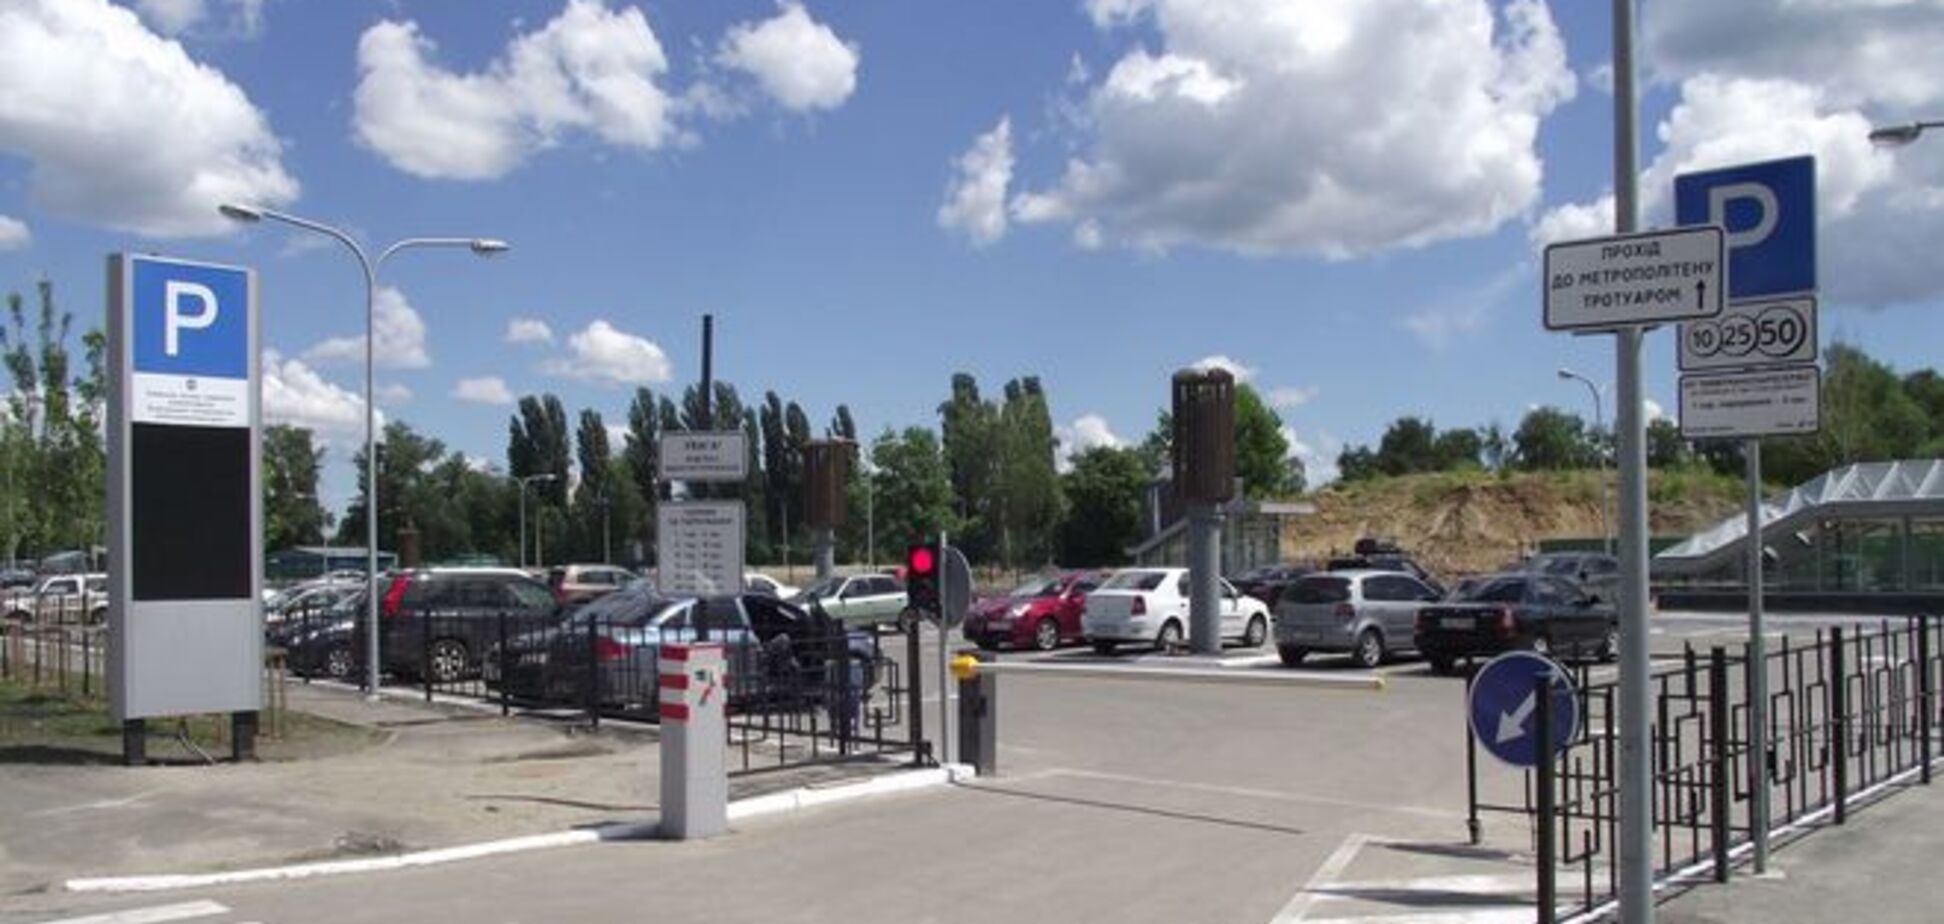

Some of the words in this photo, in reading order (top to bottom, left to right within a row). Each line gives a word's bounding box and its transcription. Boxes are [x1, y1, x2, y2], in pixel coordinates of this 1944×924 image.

[1709, 181, 1779, 249] P
[1602, 241, 1662, 260] ПРОХІД
[1552, 273, 1575, 290] ДО
[1578, 261, 1715, 286] МЕТРОПОЛІТЕНУ
[1584, 288, 1681, 309] ТРОТУАРОМ
[164, 279, 219, 357] P
[1692, 328, 1713, 348] 10
[1724, 323, 1751, 346] 25
[1760, 317, 1798, 346] 50
